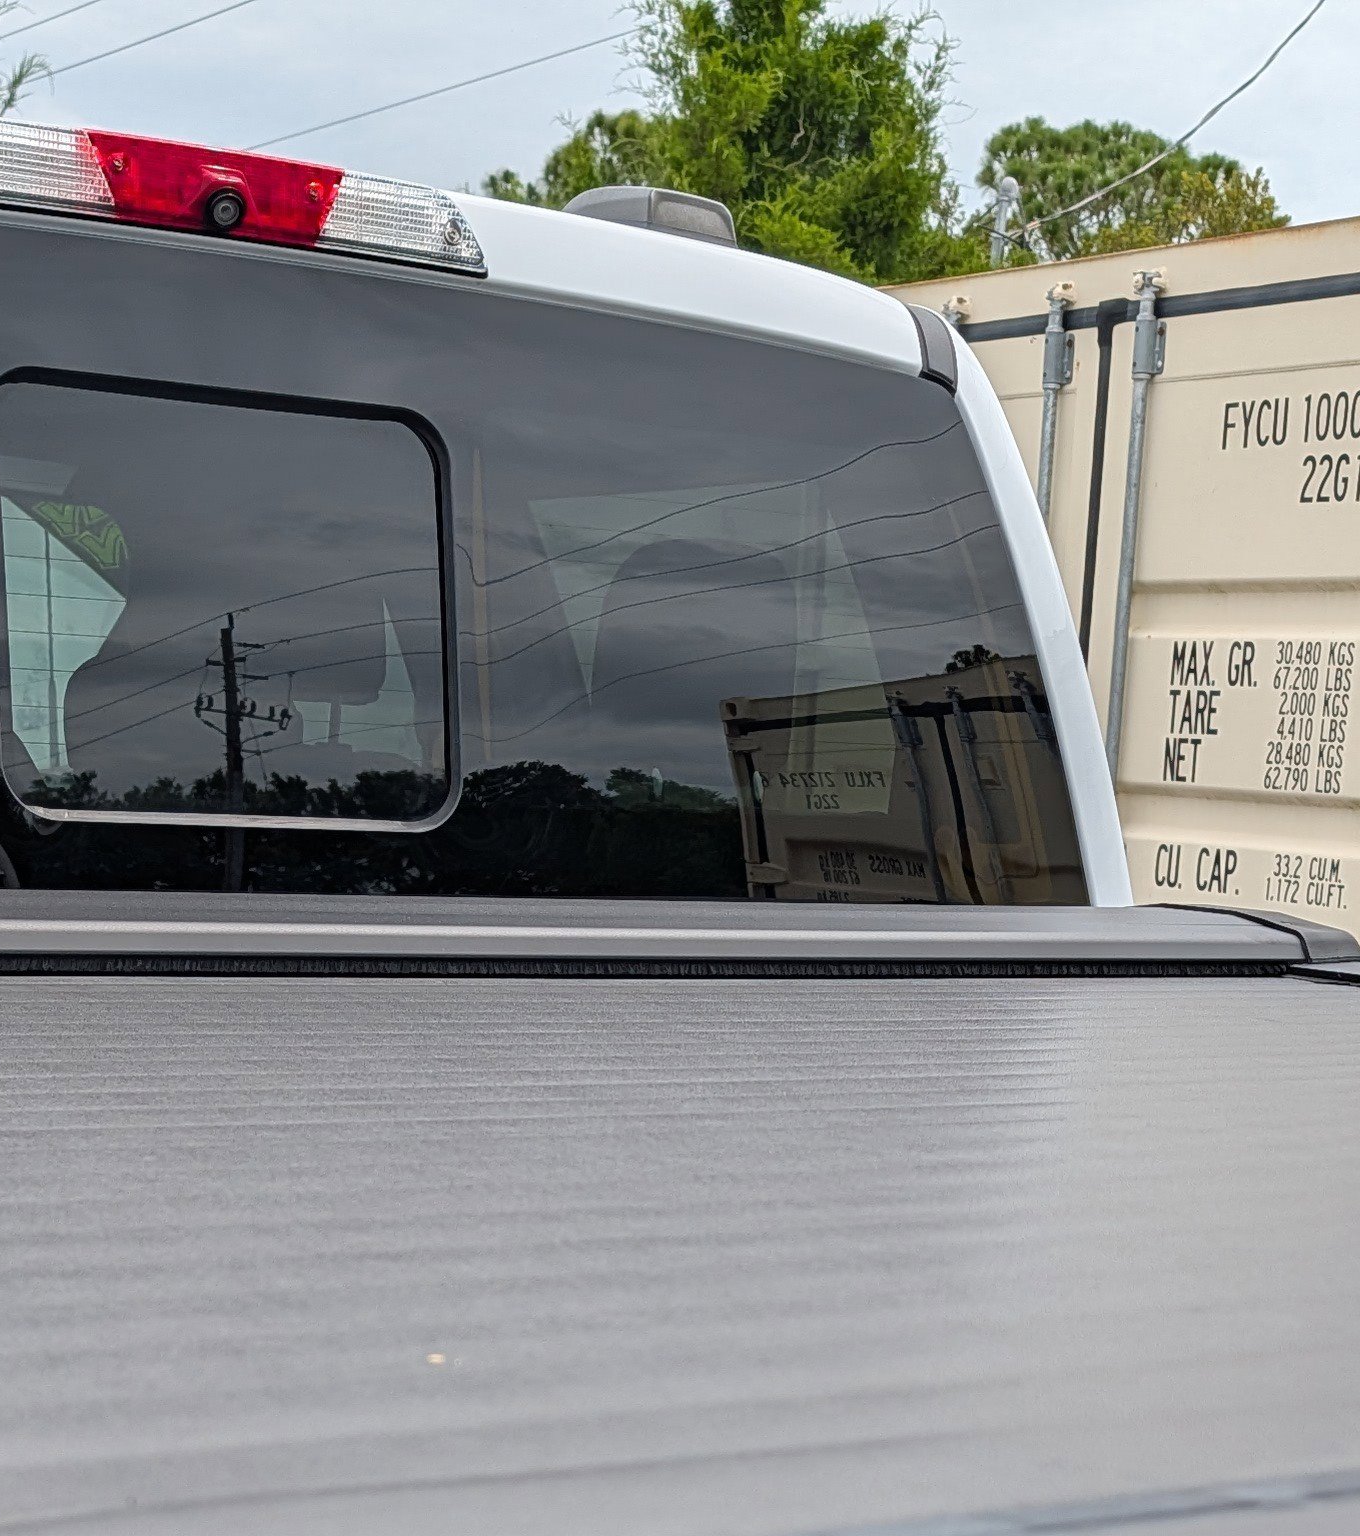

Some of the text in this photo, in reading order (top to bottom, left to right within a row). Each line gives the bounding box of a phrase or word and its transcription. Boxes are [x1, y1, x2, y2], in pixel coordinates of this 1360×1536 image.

[1221, 397, 1290, 451] FYCU
[1169, 640, 1216, 687] MAX.
[1227, 640, 1258, 688] GR.
[1327, 641, 1356, 667] KGS
[1324, 667, 1353, 693] LBS
[1169, 689, 1222, 736] TARE
[1321, 692, 1350, 718] KGS
[1319, 718, 1347, 744] LBS
[1162, 737, 1203, 783] NET
[1317, 743, 1344, 769] KGS
[1314, 769, 1342, 795] LBS
[1154, 843, 1182, 890] CU.
[1195, 847, 1240, 896] CAP.
